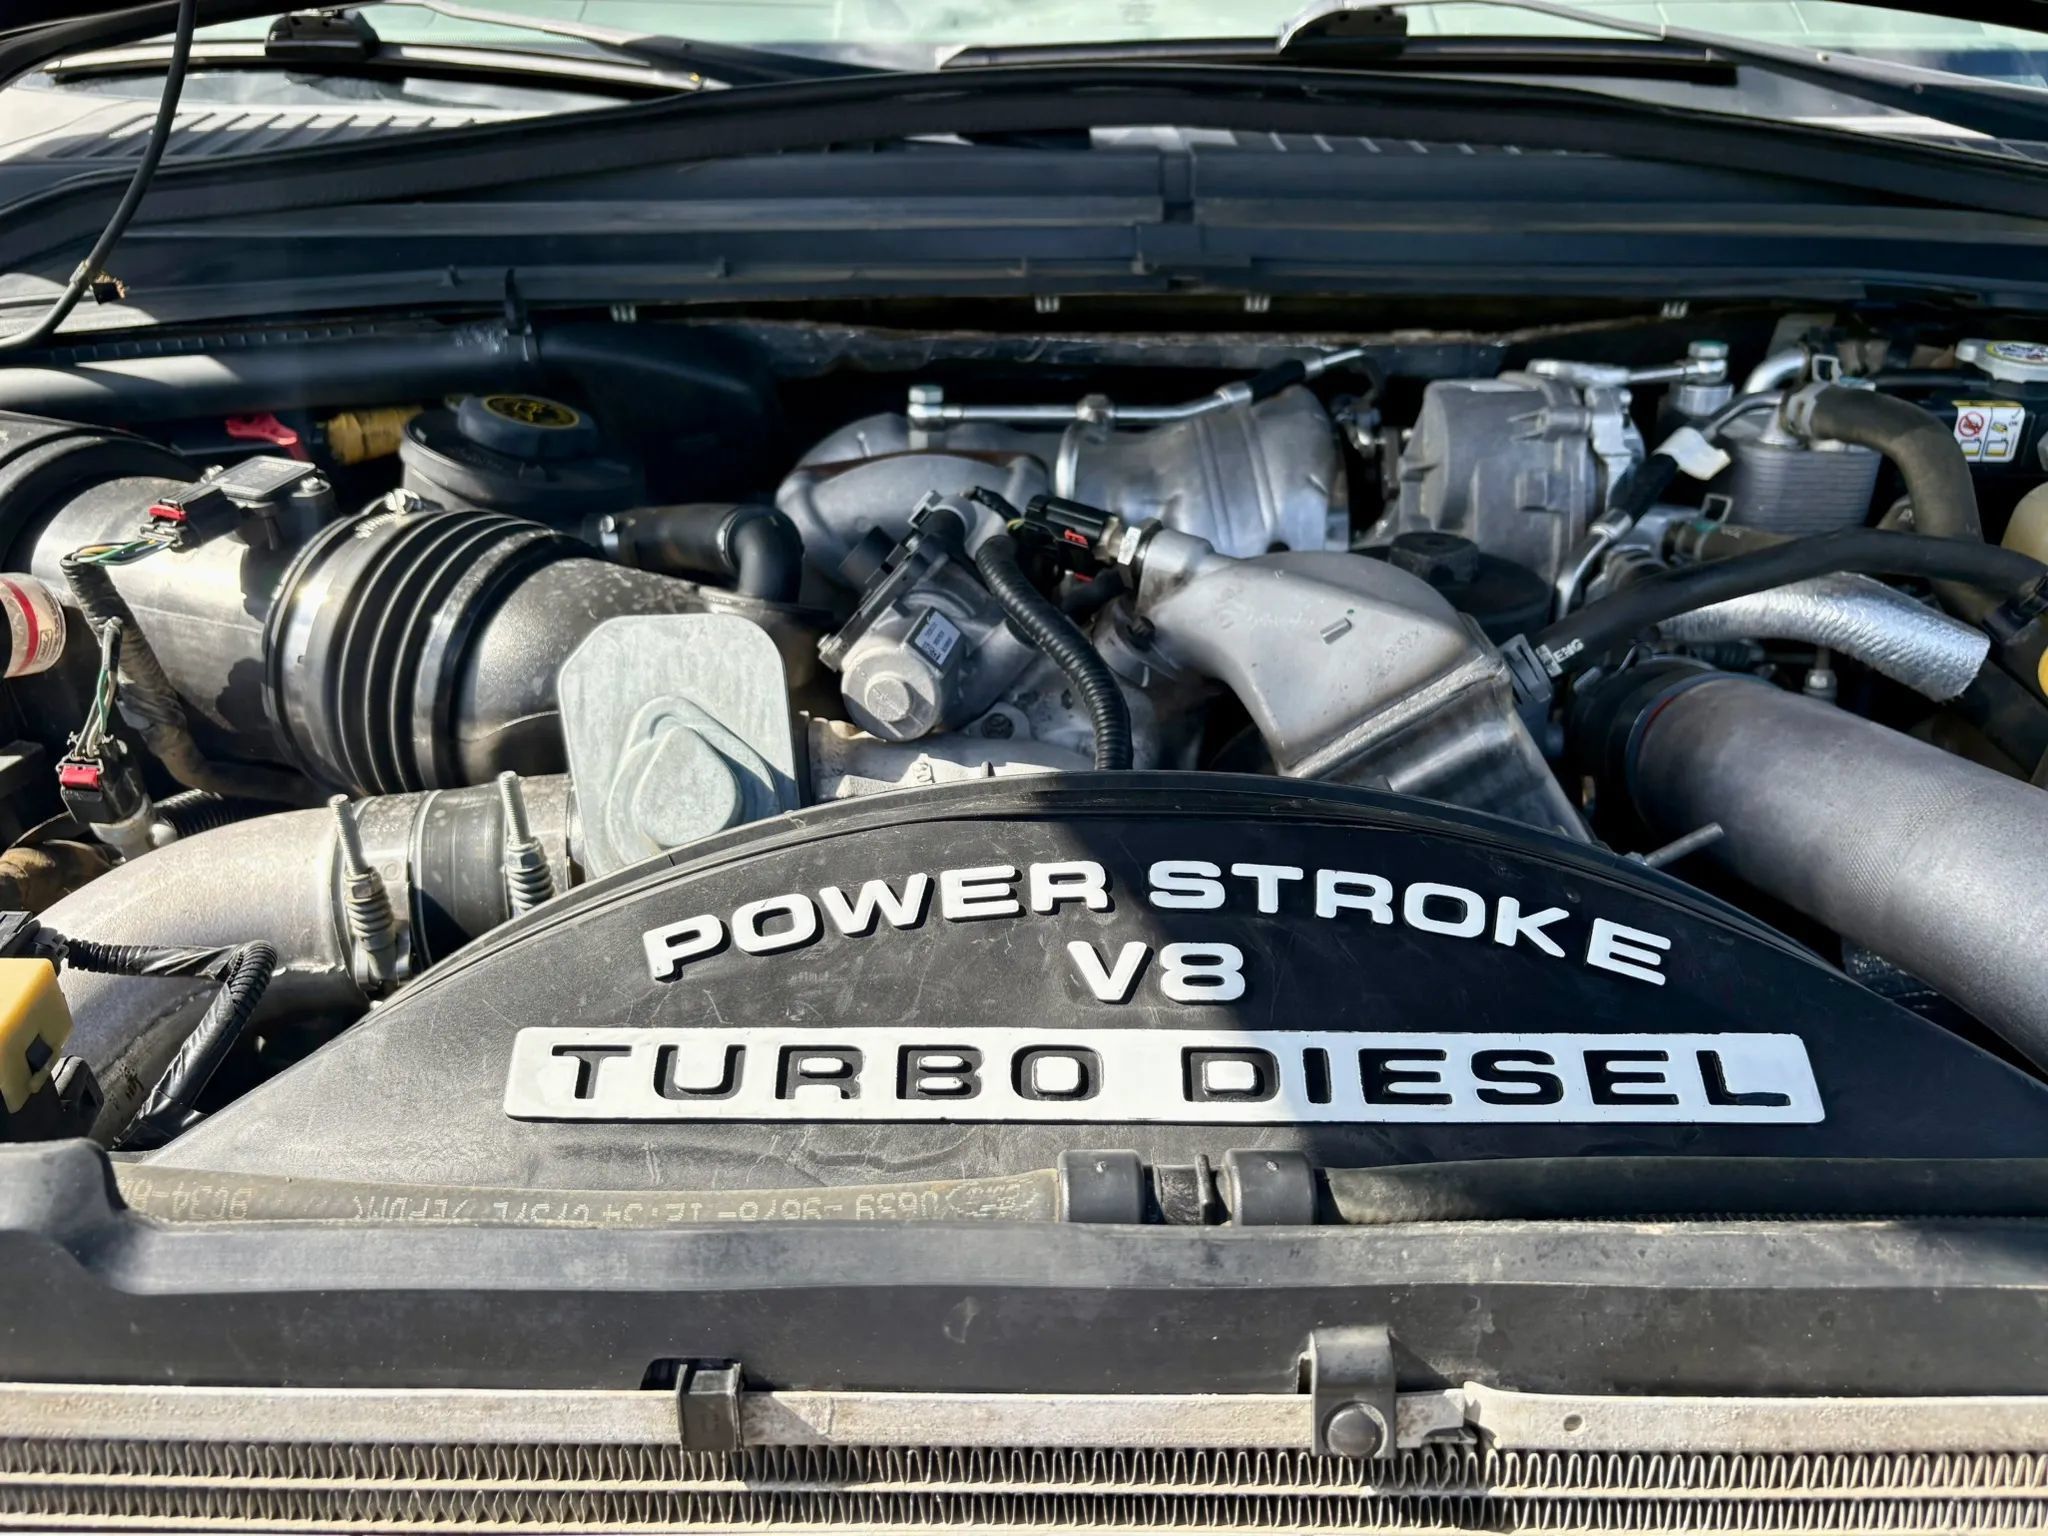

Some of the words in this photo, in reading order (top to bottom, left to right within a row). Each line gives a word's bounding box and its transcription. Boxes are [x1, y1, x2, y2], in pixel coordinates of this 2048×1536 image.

[642, 861, 1108, 986] POWER
[1149, 861, 1671, 986] STROKE
[1066, 941, 1247, 1003] V8
[552, 1045, 1104, 1101] TURBO
[1181, 1046, 1791, 1106] DIESEL
